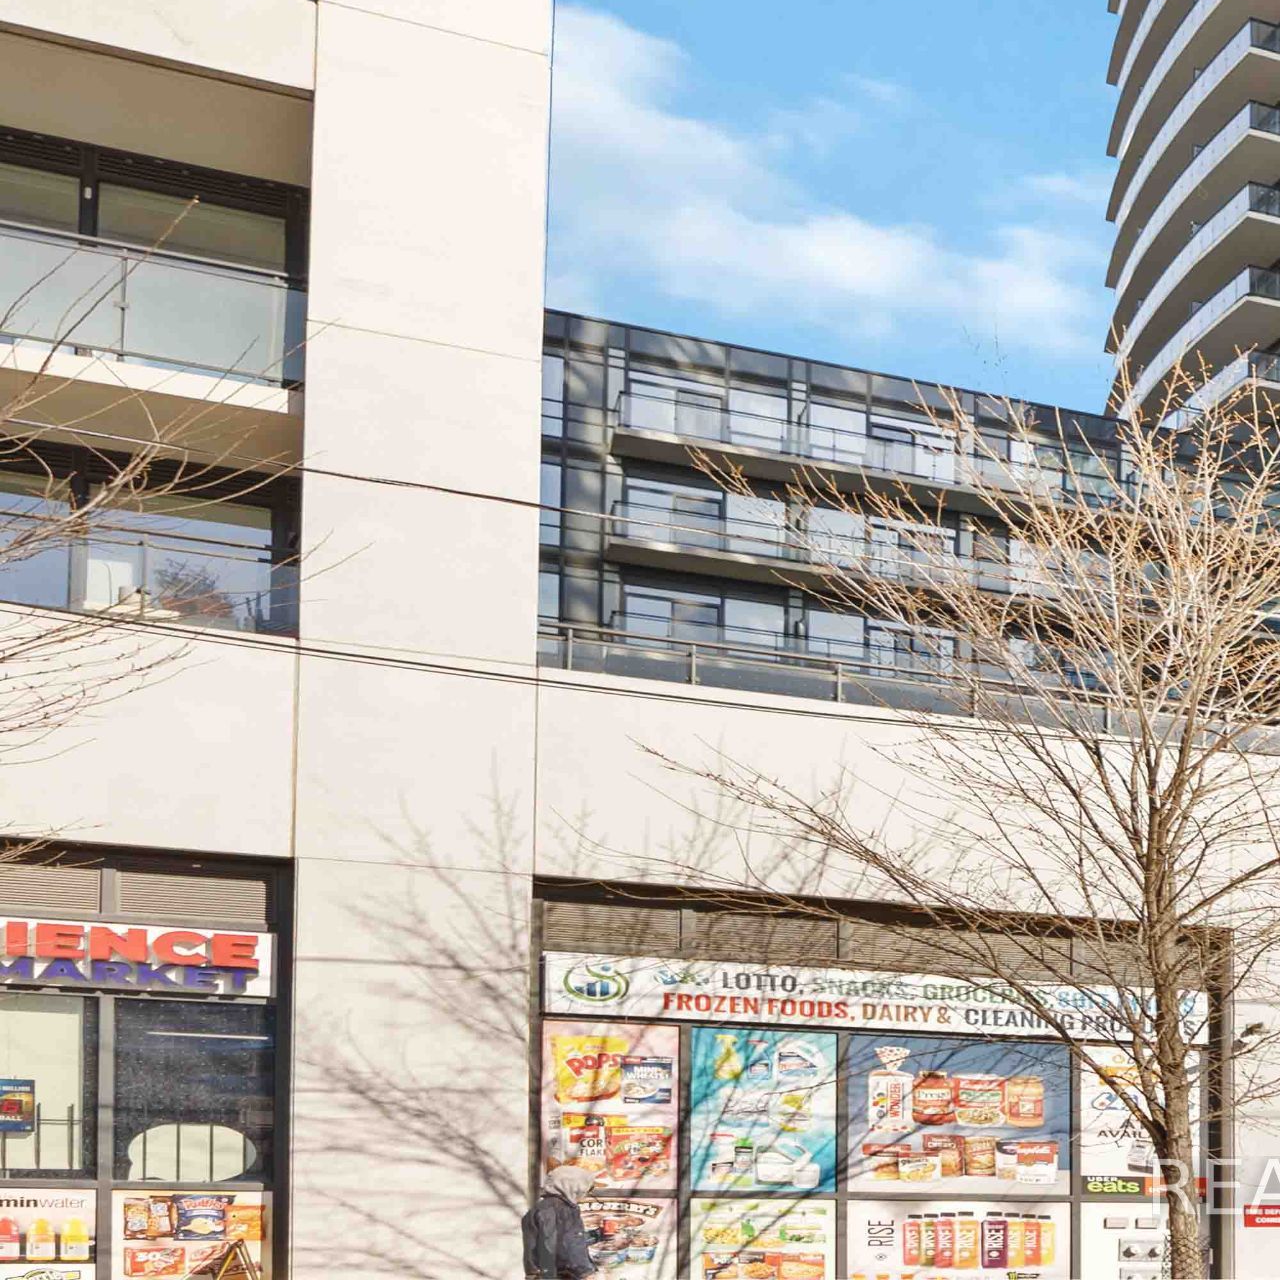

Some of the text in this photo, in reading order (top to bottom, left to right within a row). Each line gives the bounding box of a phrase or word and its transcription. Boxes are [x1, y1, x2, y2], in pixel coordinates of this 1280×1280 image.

[0, 956, 258, 990] MARKET
[721, 971, 804, 994] LOTTO,
[662, 992, 758, 1015] FROZEN
[767, 997, 855, 1020] FOODS,
[861, 1002, 930, 1023] DAIRY
[964, 1007, 1075, 1030] CLEANING
[565, 1053, 620, 1077] POPS
[889, 1082, 902, 1118] WONDER
[1097, 1129, 1152, 1139] AVAIL
[1087, 1181, 1141, 1193] eats
[867, 1219, 895, 1247] RISE
[986, 1227, 1005, 1249] RISE
